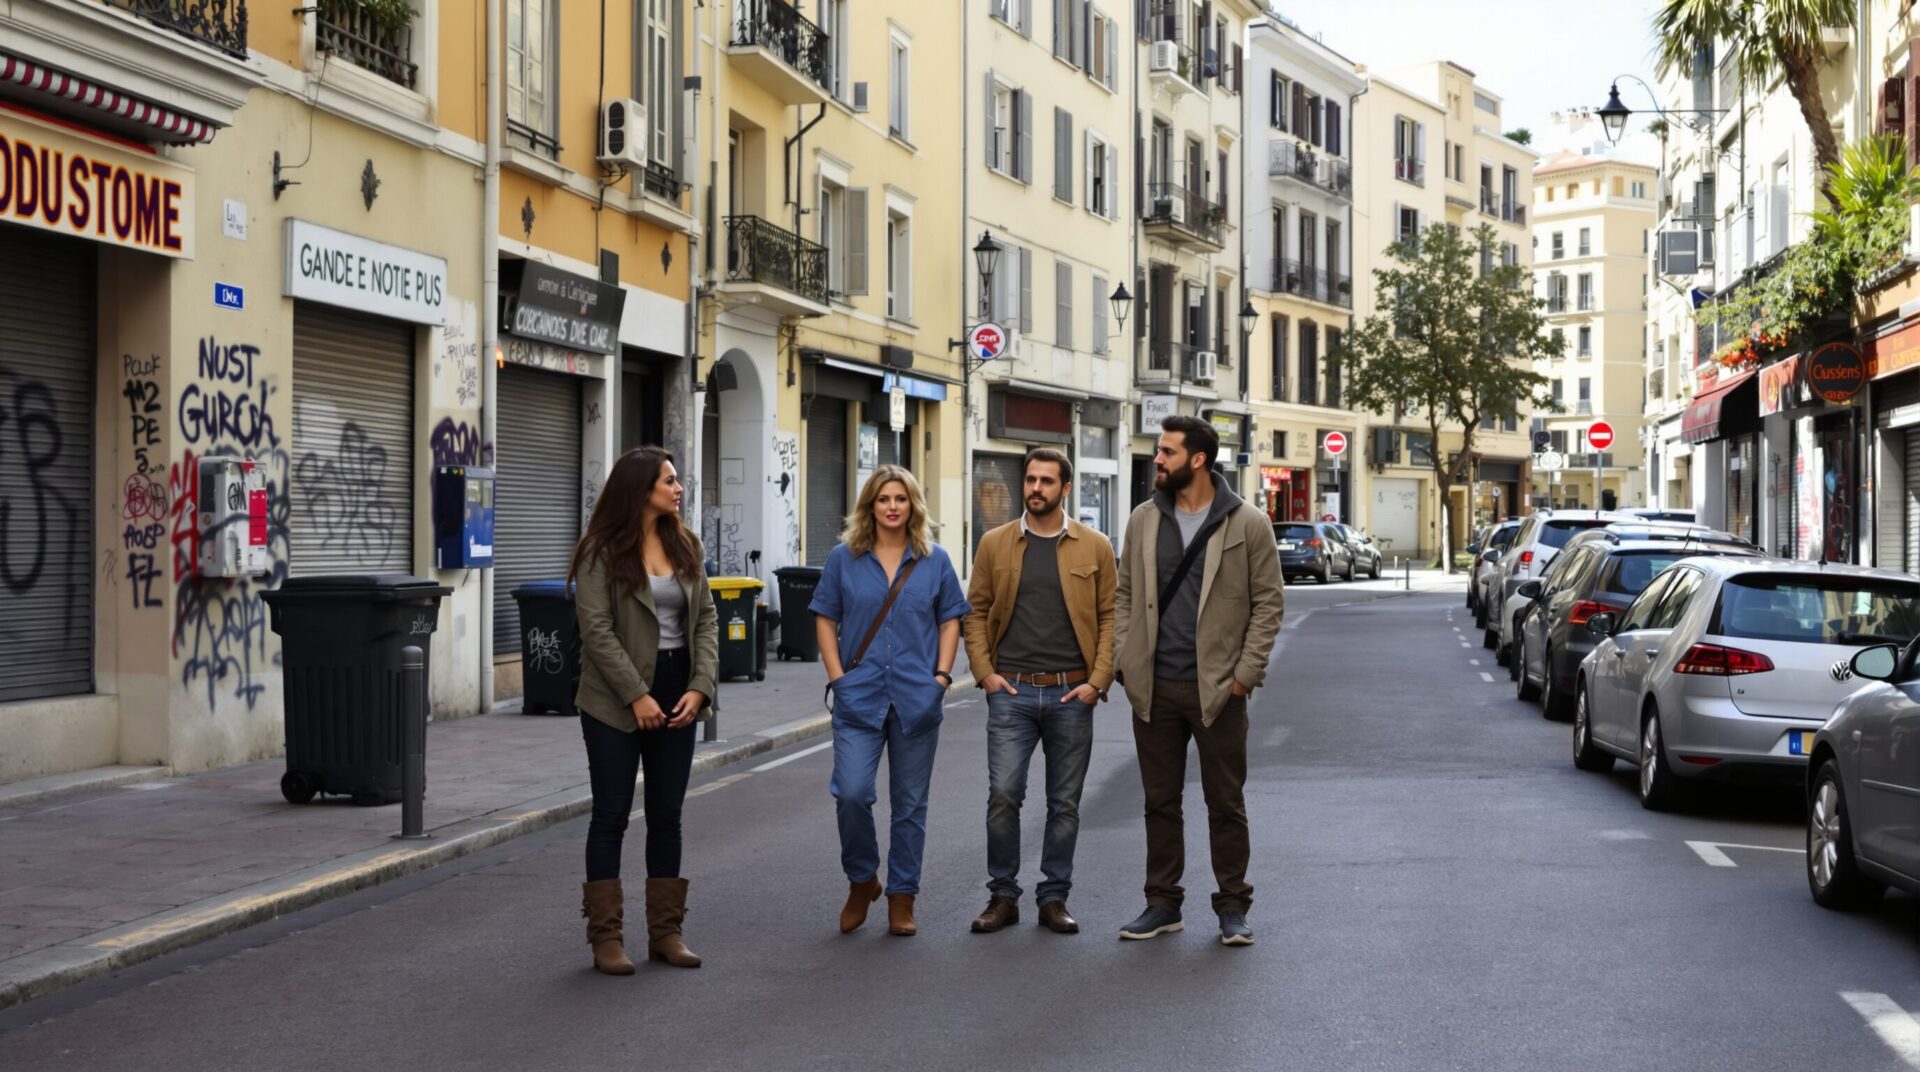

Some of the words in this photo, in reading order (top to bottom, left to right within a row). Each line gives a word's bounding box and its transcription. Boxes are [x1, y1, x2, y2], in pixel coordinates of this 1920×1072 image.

[300, 243, 354, 287] GANDE
[358, 256, 366, 290] E
[416, 270, 442, 307] PUS
[198, 335, 261, 389] NUST
